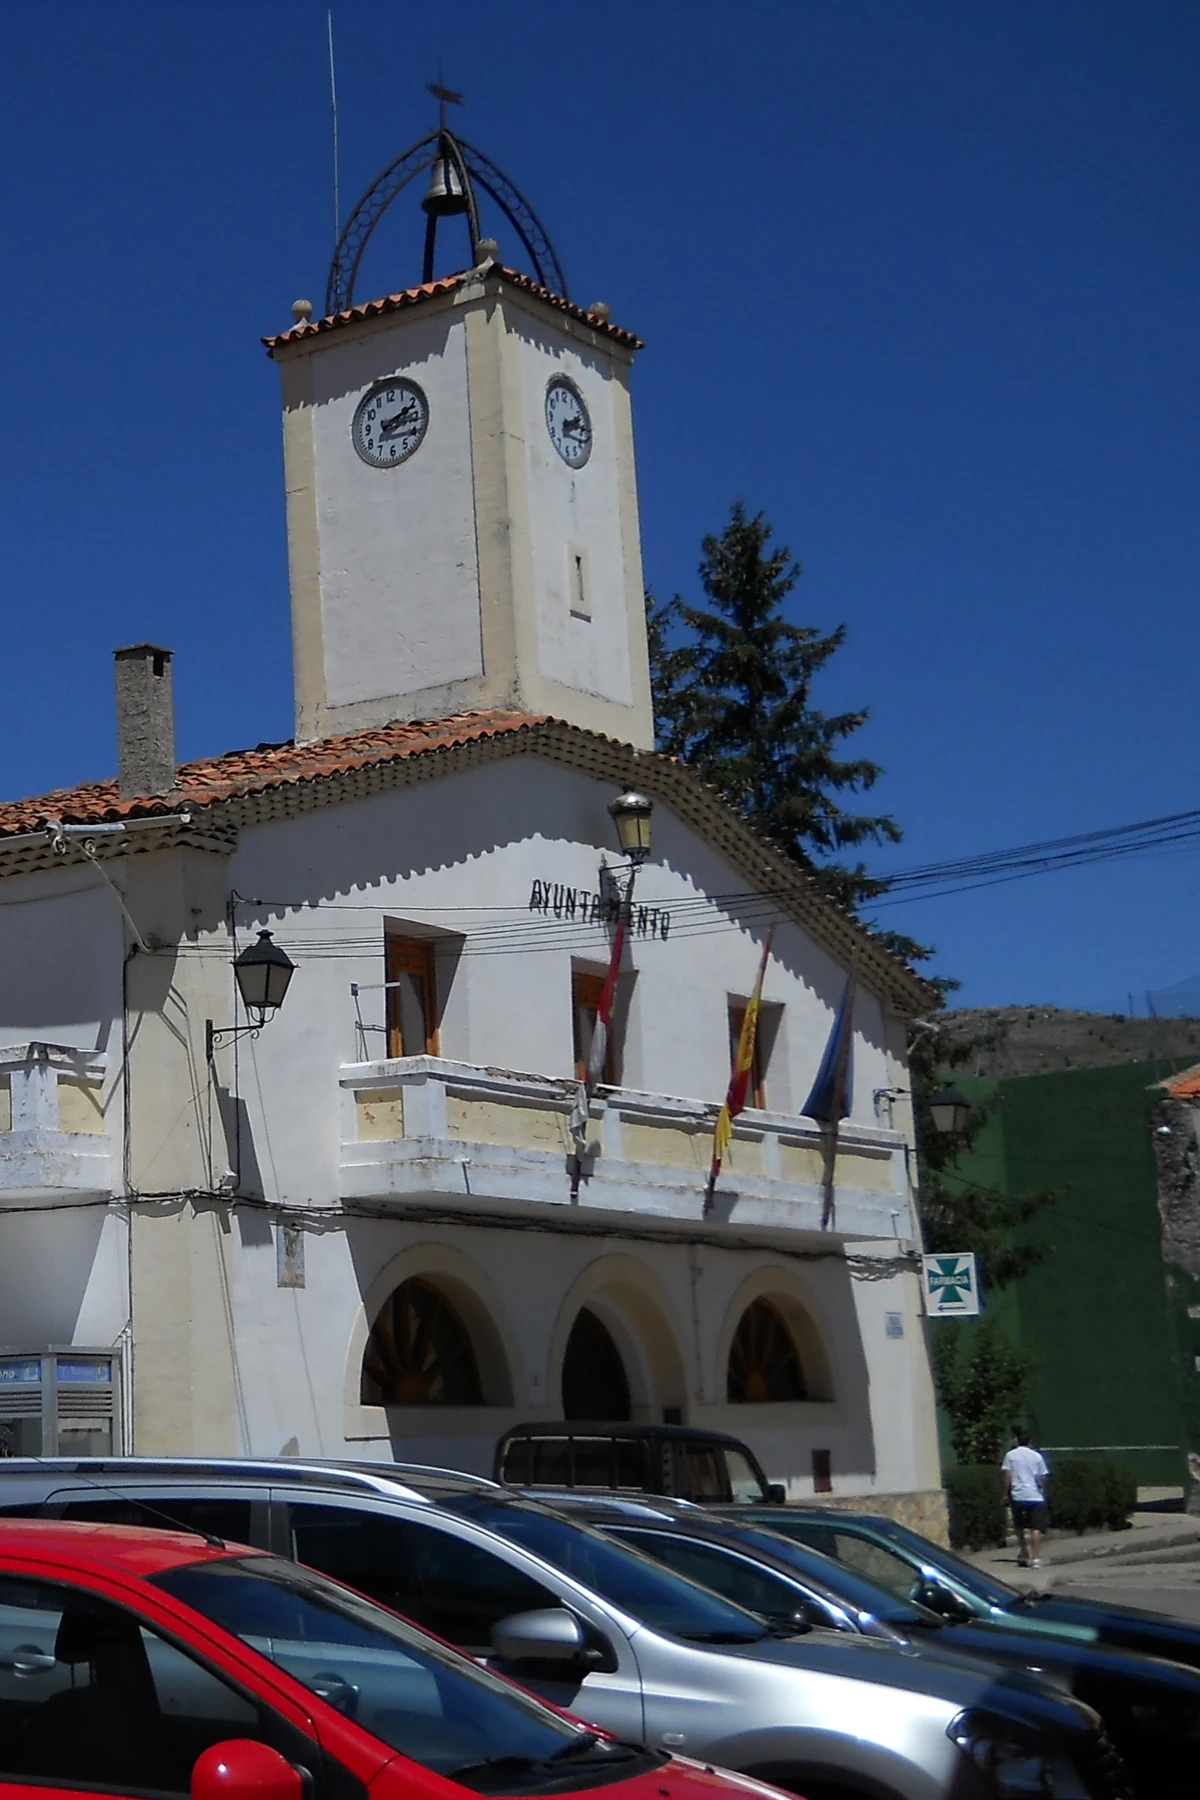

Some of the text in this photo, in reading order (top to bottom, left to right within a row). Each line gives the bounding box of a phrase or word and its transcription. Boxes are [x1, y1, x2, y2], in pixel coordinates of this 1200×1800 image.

[386, 390, 395, 403] 12
[367, 409, 376, 421] 10
[365, 424, 371, 436] 9
[368, 438, 374, 450] 8
[377, 444, 383, 456] 7
[390, 445, 396, 456] 6
[530, 879, 670, 941] AYUNTAENTO
[930, 1275, 969, 1285] FARMACIA
